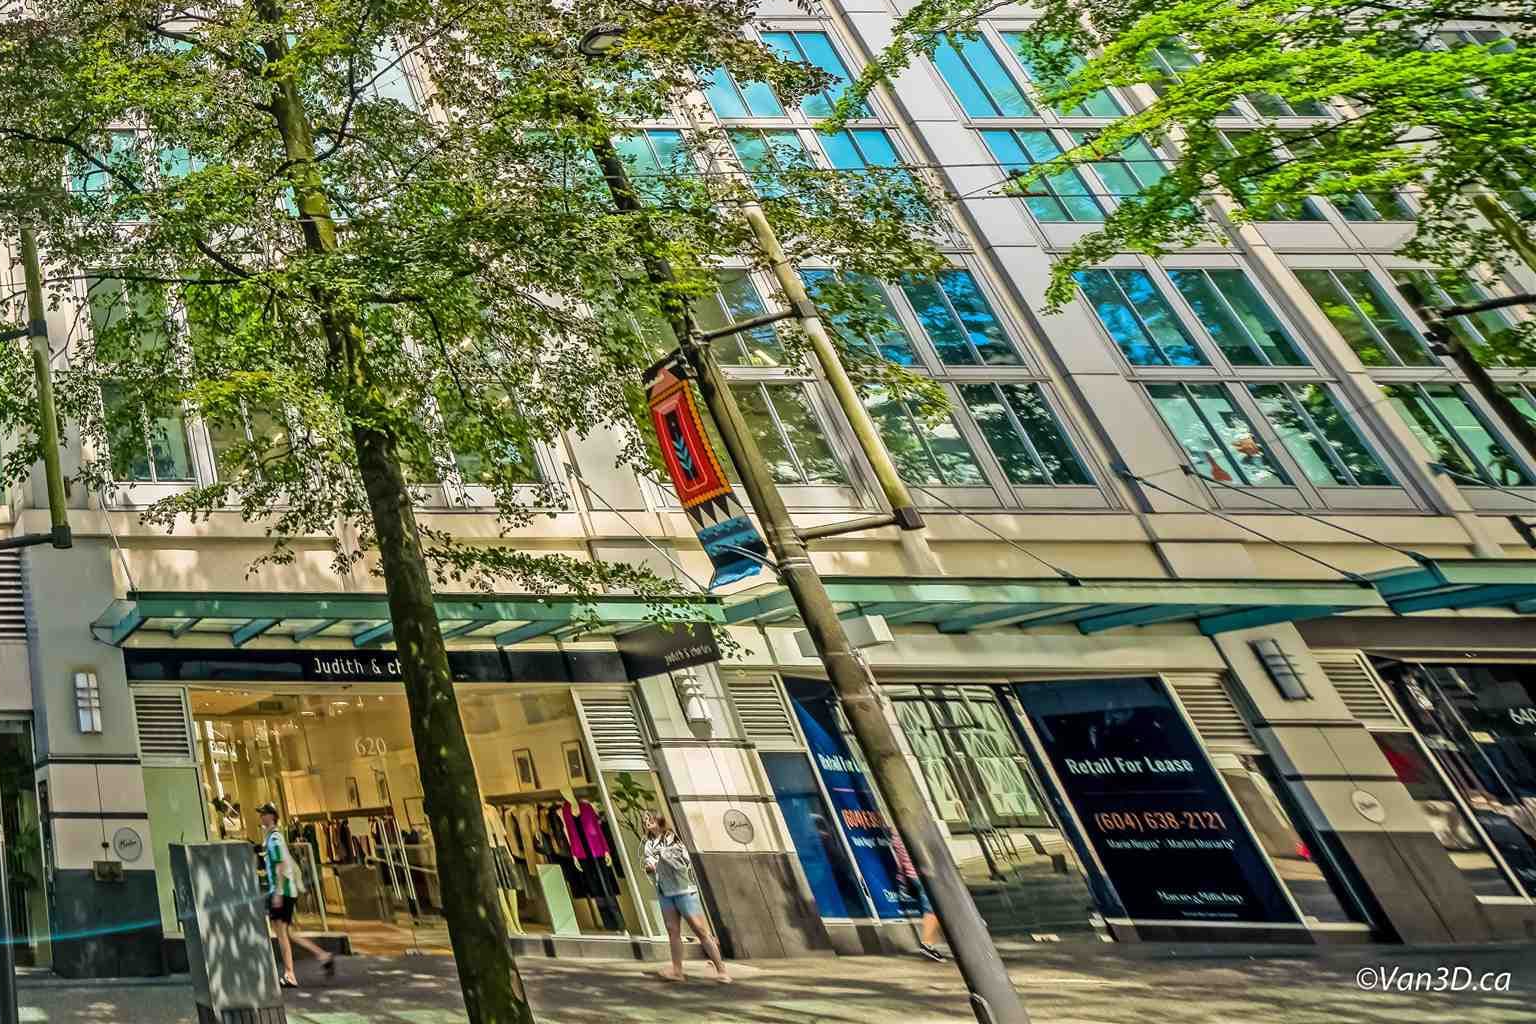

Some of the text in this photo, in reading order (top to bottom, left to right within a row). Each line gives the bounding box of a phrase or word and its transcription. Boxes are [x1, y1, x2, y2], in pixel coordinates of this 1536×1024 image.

[313, 657, 365, 675] Judith
[370, 658, 382, 674] &
[353, 736, 387, 756] 620
[1064, 756, 1194, 775] Retail For Lease
[1093, 810, 1228, 833] (604) 638-2121
